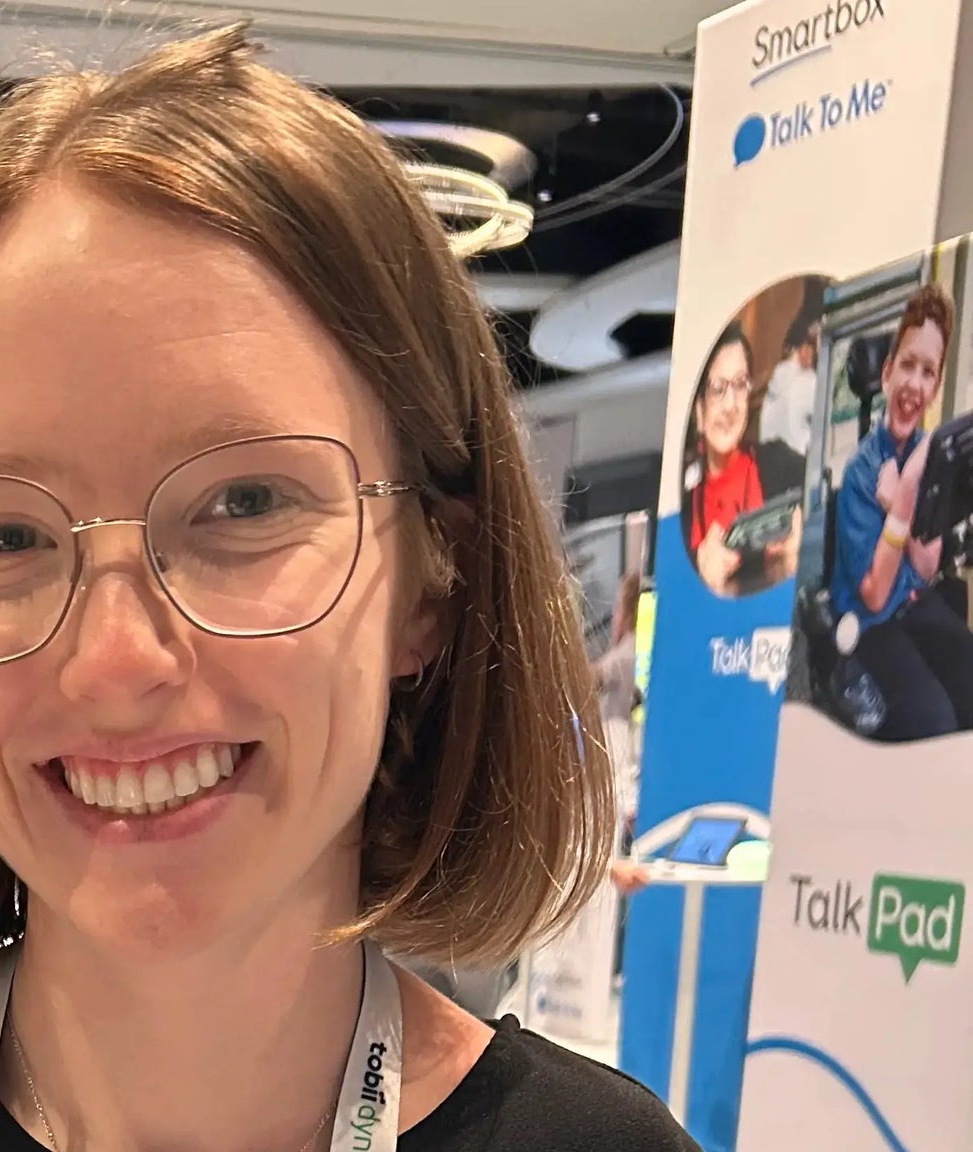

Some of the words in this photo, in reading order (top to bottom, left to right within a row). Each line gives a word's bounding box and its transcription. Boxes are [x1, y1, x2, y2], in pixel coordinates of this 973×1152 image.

[752, 0, 884, 67] Smartbox
[768, 102, 813, 148] Talk
[818, 94, 843, 129] To
[709, 637, 749, 675] Talk
[790, 875, 864, 935] Talk
[874, 885, 957, 951] Pad
